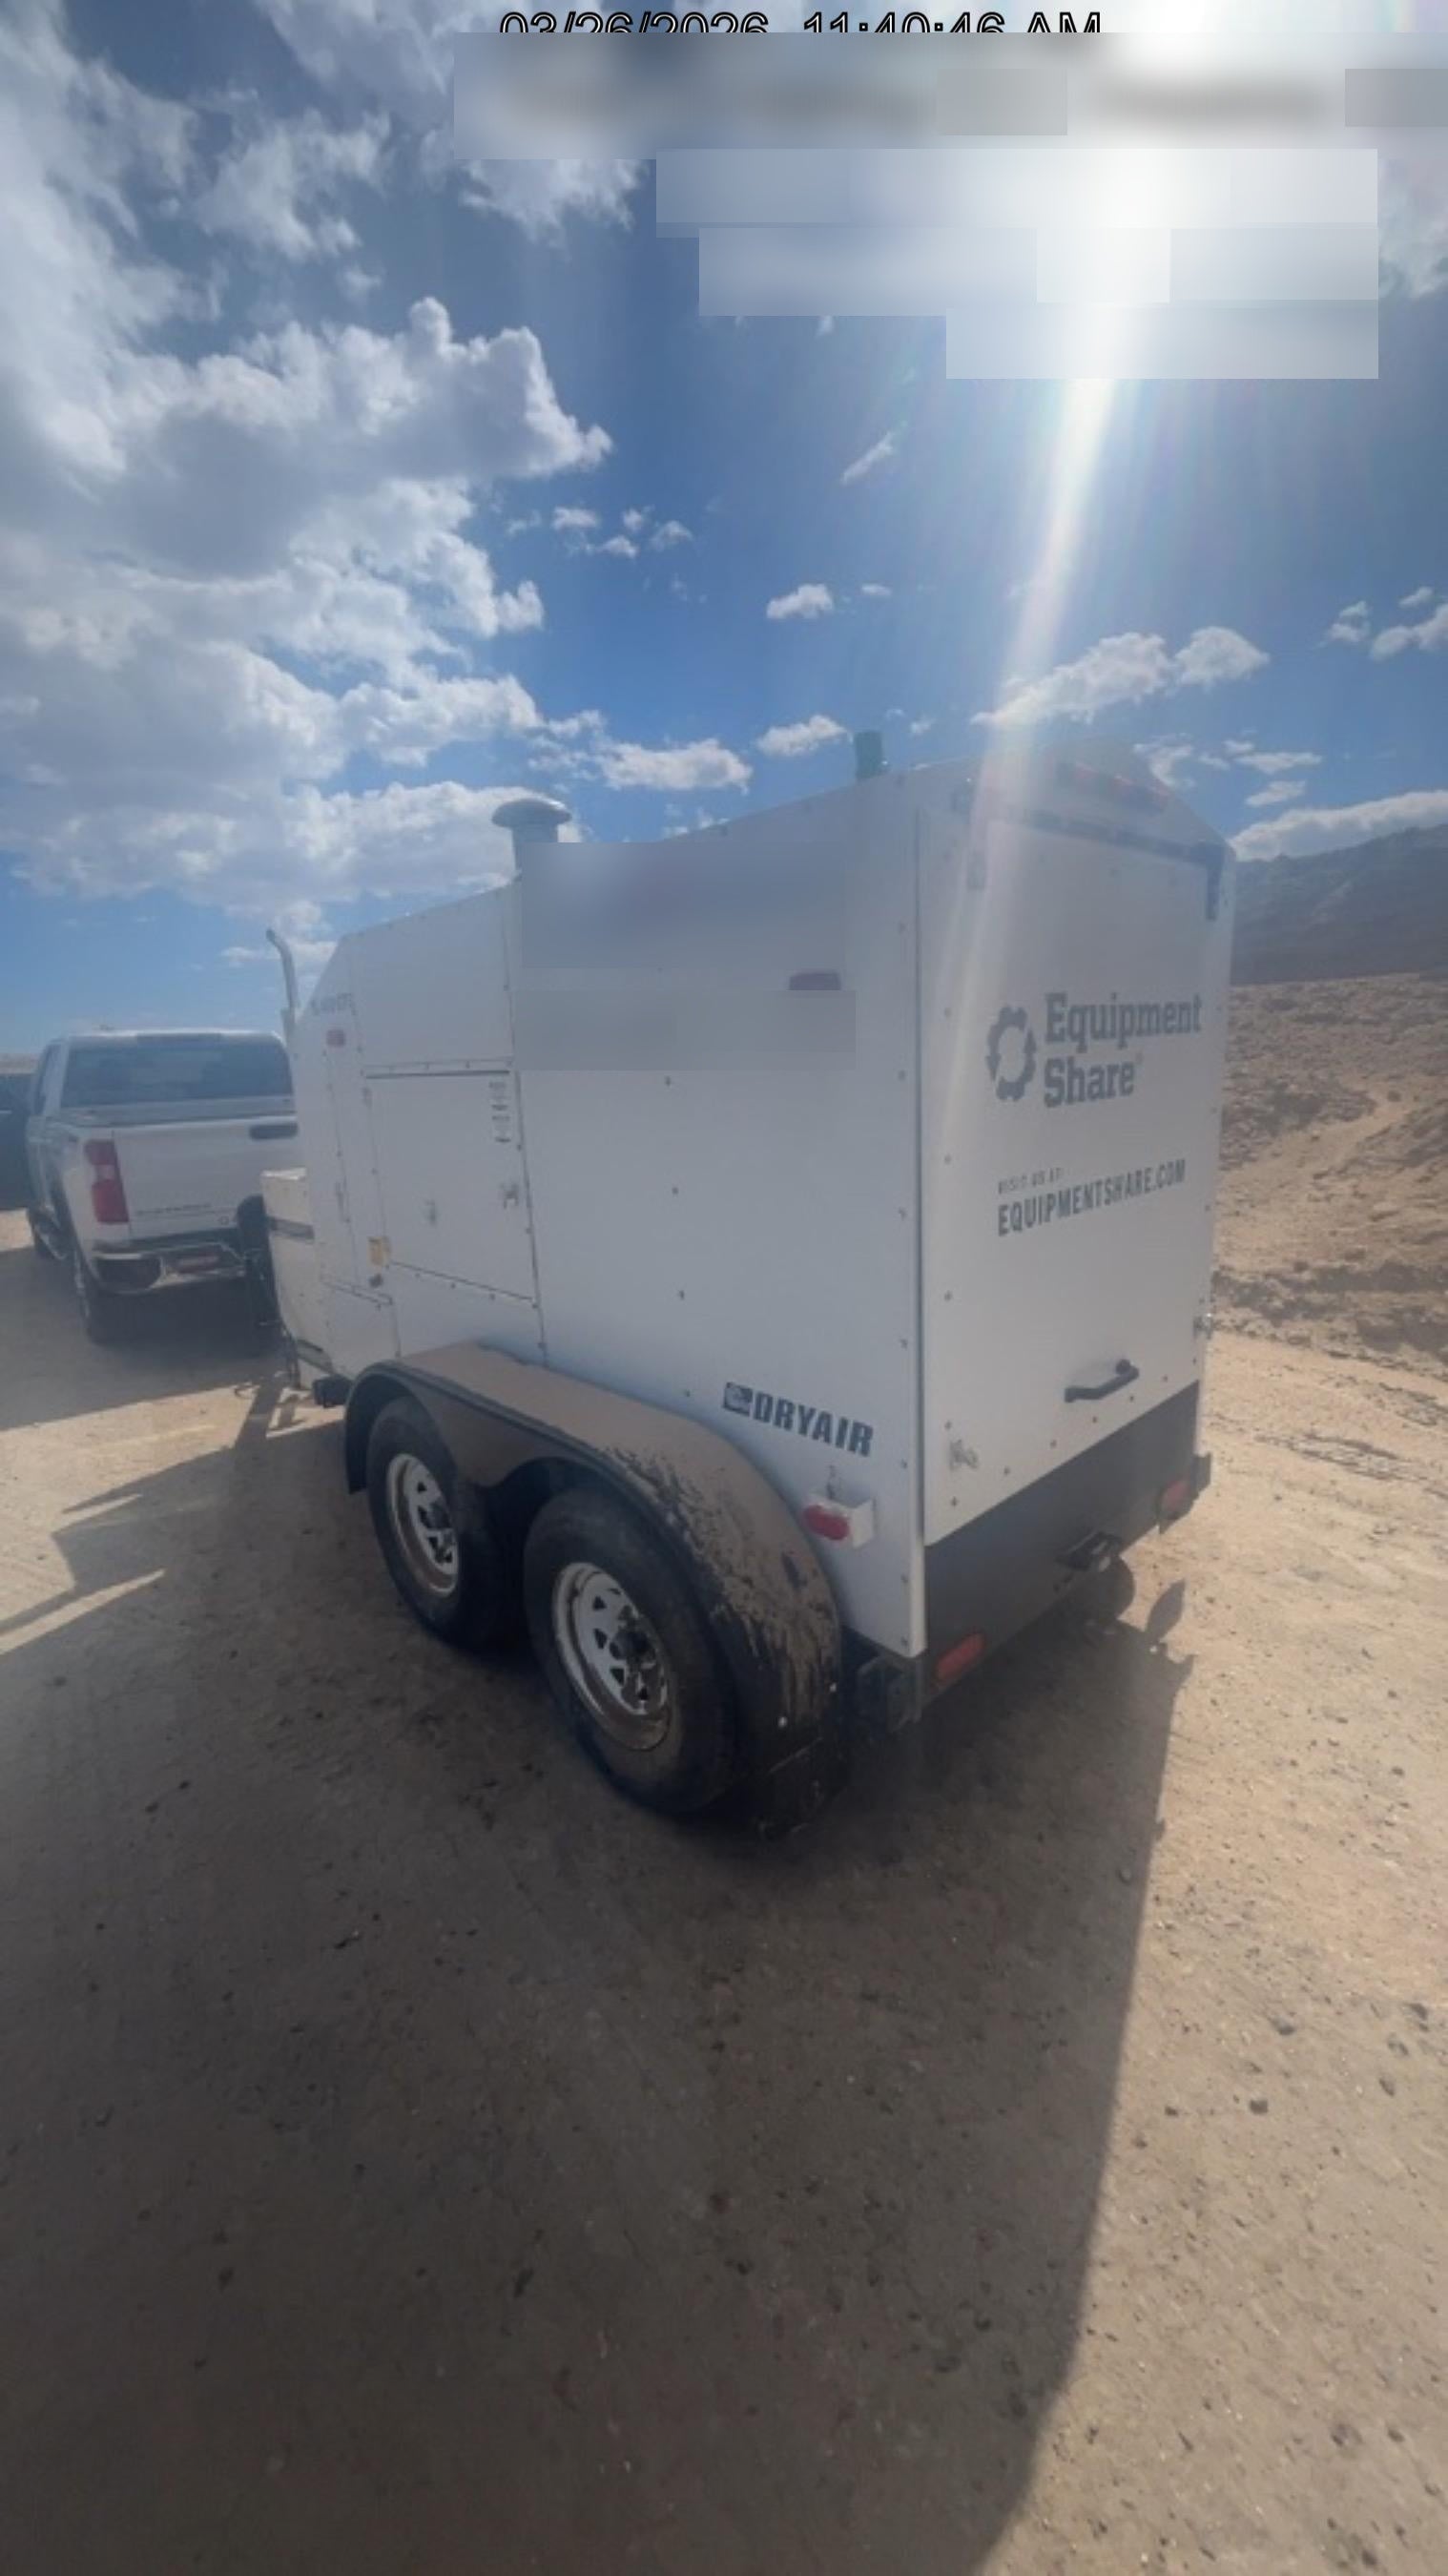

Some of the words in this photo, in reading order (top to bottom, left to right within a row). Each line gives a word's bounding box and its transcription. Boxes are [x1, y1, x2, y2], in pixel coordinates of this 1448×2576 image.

[1045, 992, 1201, 1053] Equipment
[1045, 1056, 1135, 1108] Share
[998, 1158, 1186, 1236] EQUIPMENTSHARE.COM
[753, 1390, 874, 1458] DRYAIR
